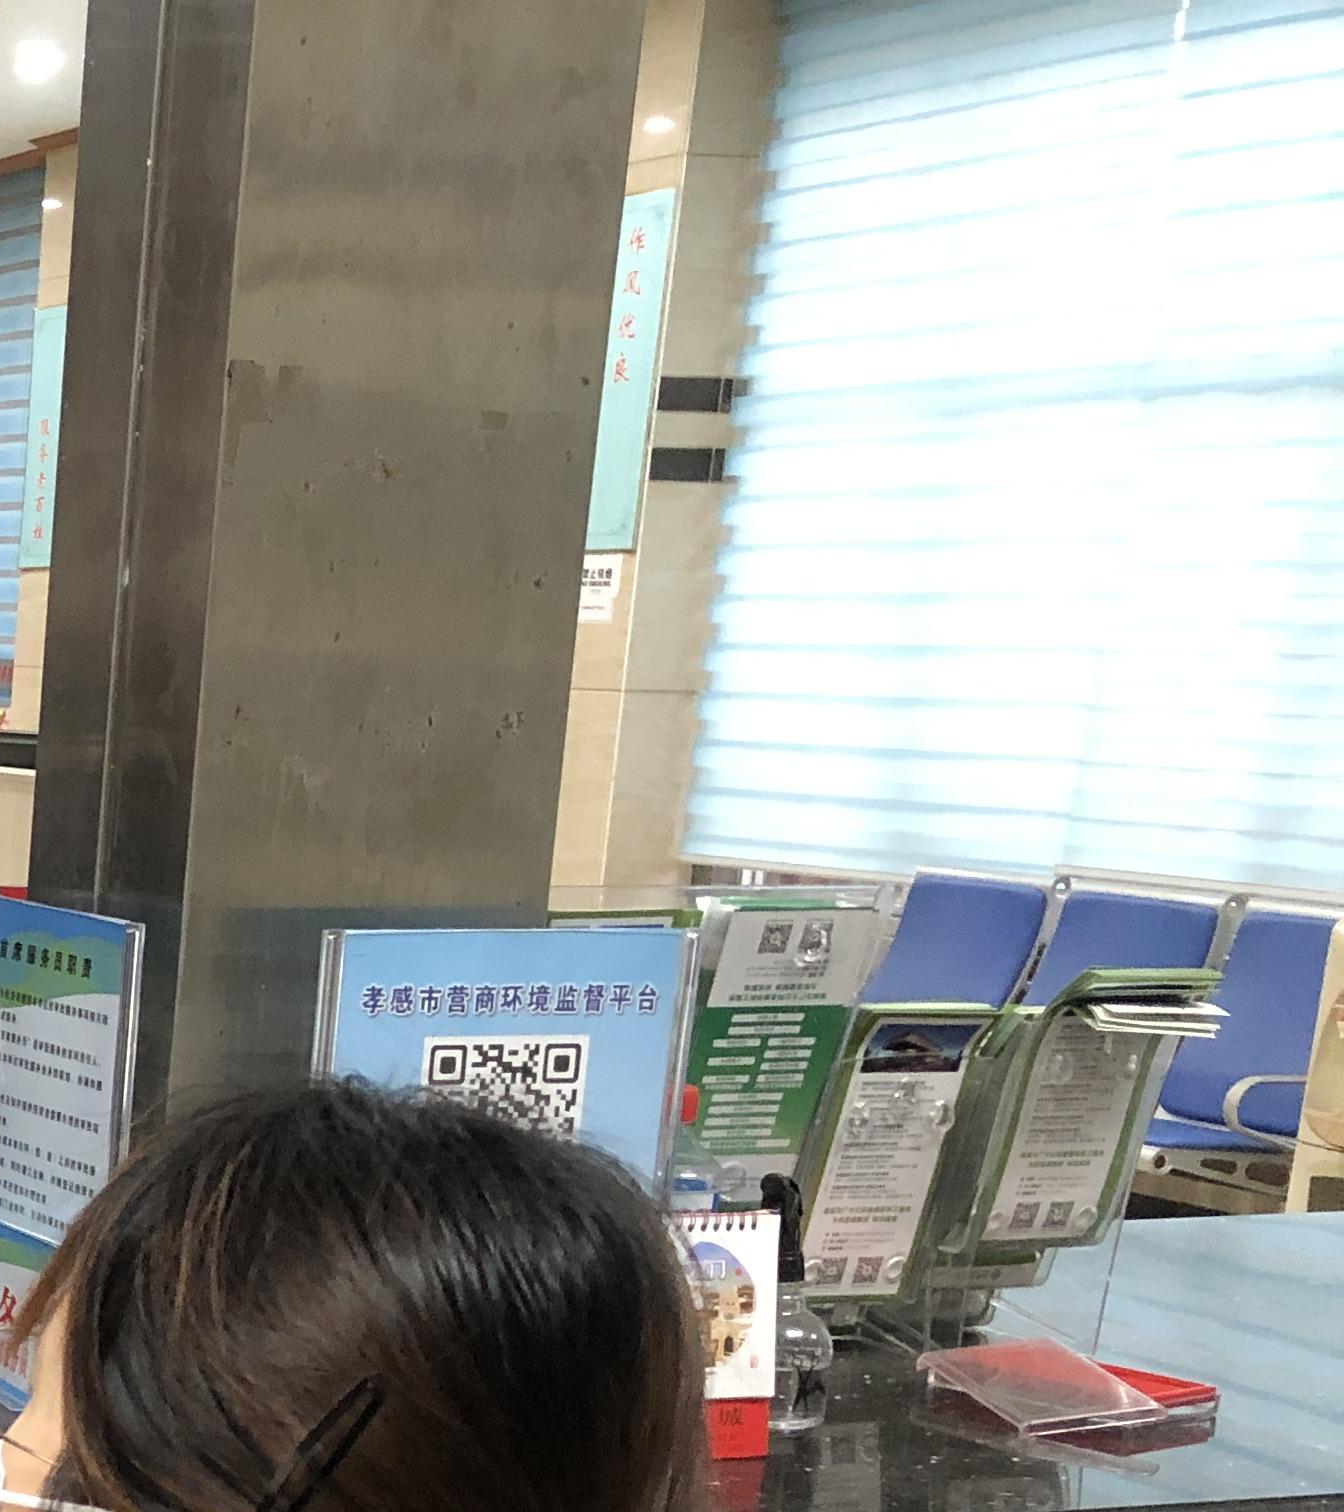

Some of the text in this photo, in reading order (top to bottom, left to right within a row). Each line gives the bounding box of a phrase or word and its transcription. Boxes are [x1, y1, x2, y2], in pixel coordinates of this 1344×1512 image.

[0, 937, 92, 979] 首席服务员职责
[362, 984, 659, 1015] 孝感市营商环境监督平台
